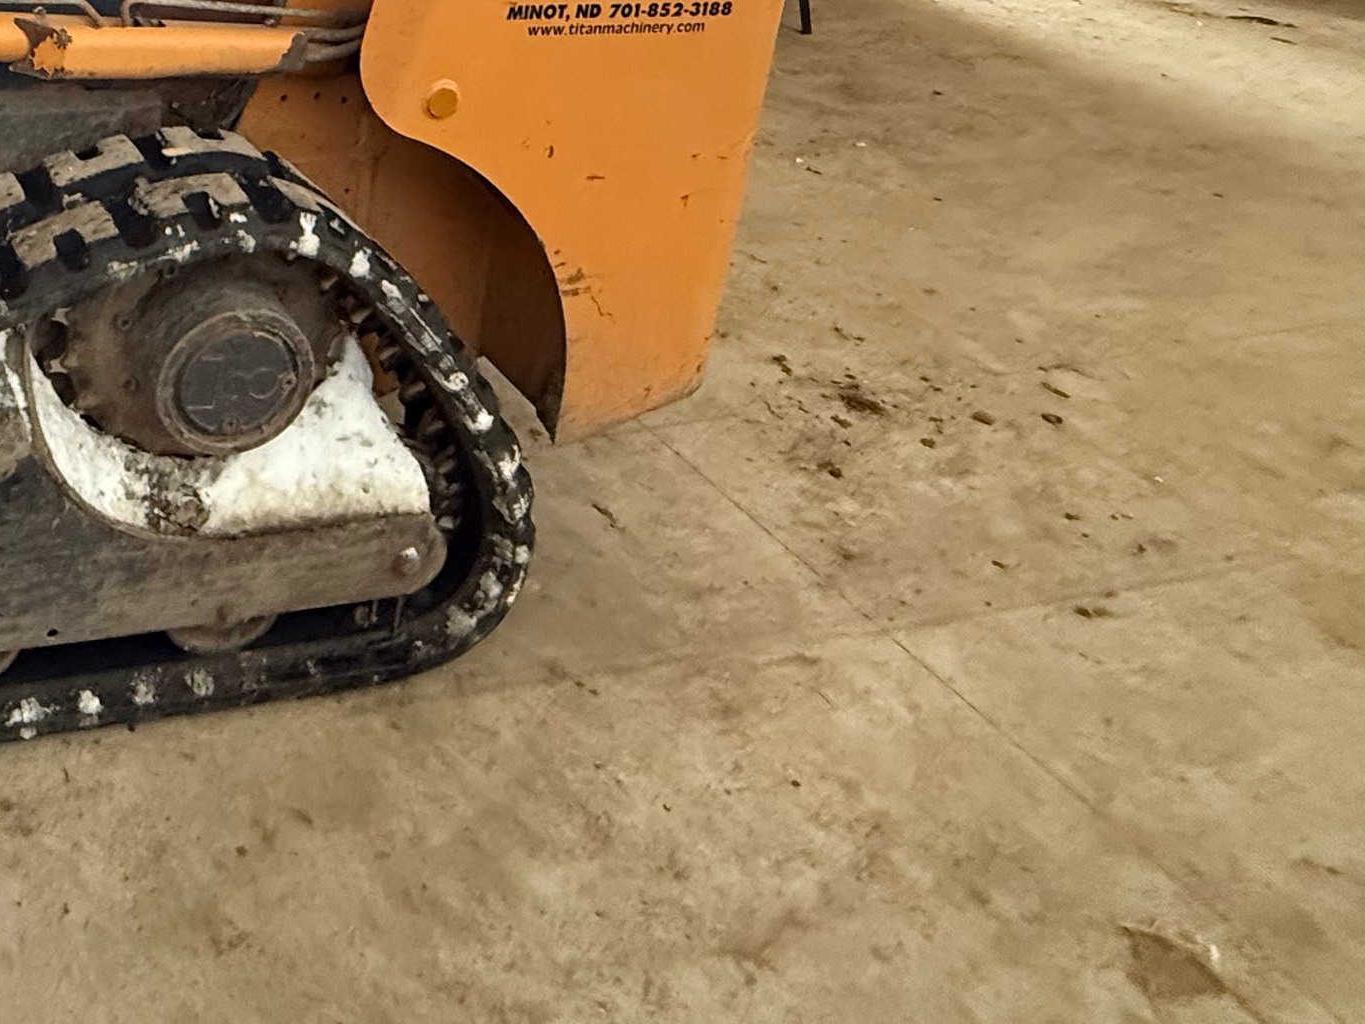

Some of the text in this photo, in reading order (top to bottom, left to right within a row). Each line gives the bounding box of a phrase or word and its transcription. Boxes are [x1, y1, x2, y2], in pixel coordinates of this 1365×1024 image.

[506, 1, 733, 21] MINOT, ND 701-852-3188
[527, 21, 706, 36] www.titanmachinery.com
